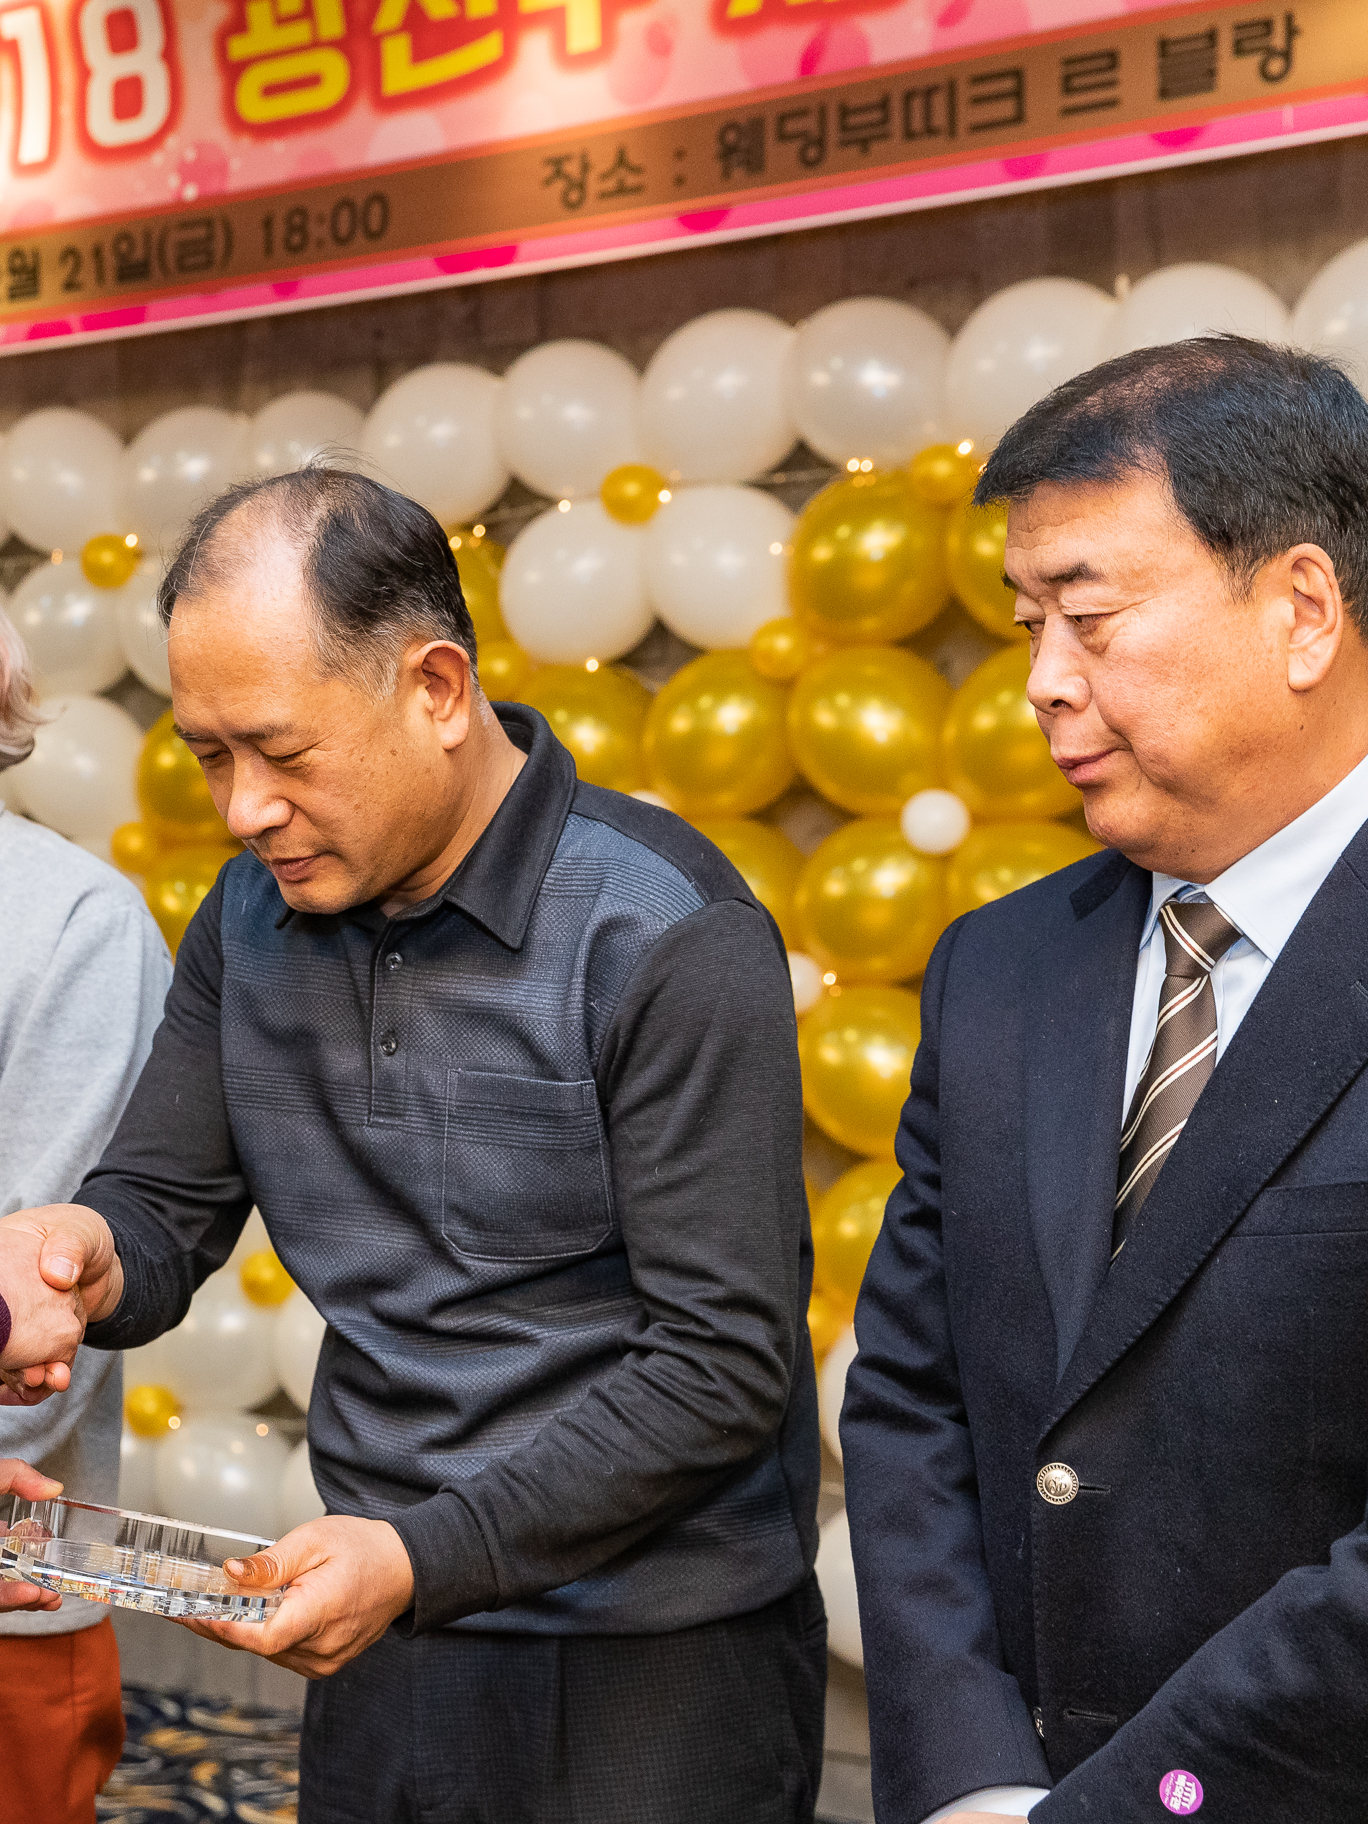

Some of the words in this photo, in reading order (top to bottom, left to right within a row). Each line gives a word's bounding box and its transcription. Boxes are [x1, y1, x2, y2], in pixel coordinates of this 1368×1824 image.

[541, 143, 645, 211] 장소
[717, 66, 1025, 181] 웨딩부띠크
[1060, 49, 1120, 118] 르
[1157, 12, 1302, 101] 블랑
[59, 213, 232, 292] 21일(금)
[262, 192, 390, 258] 18:00
